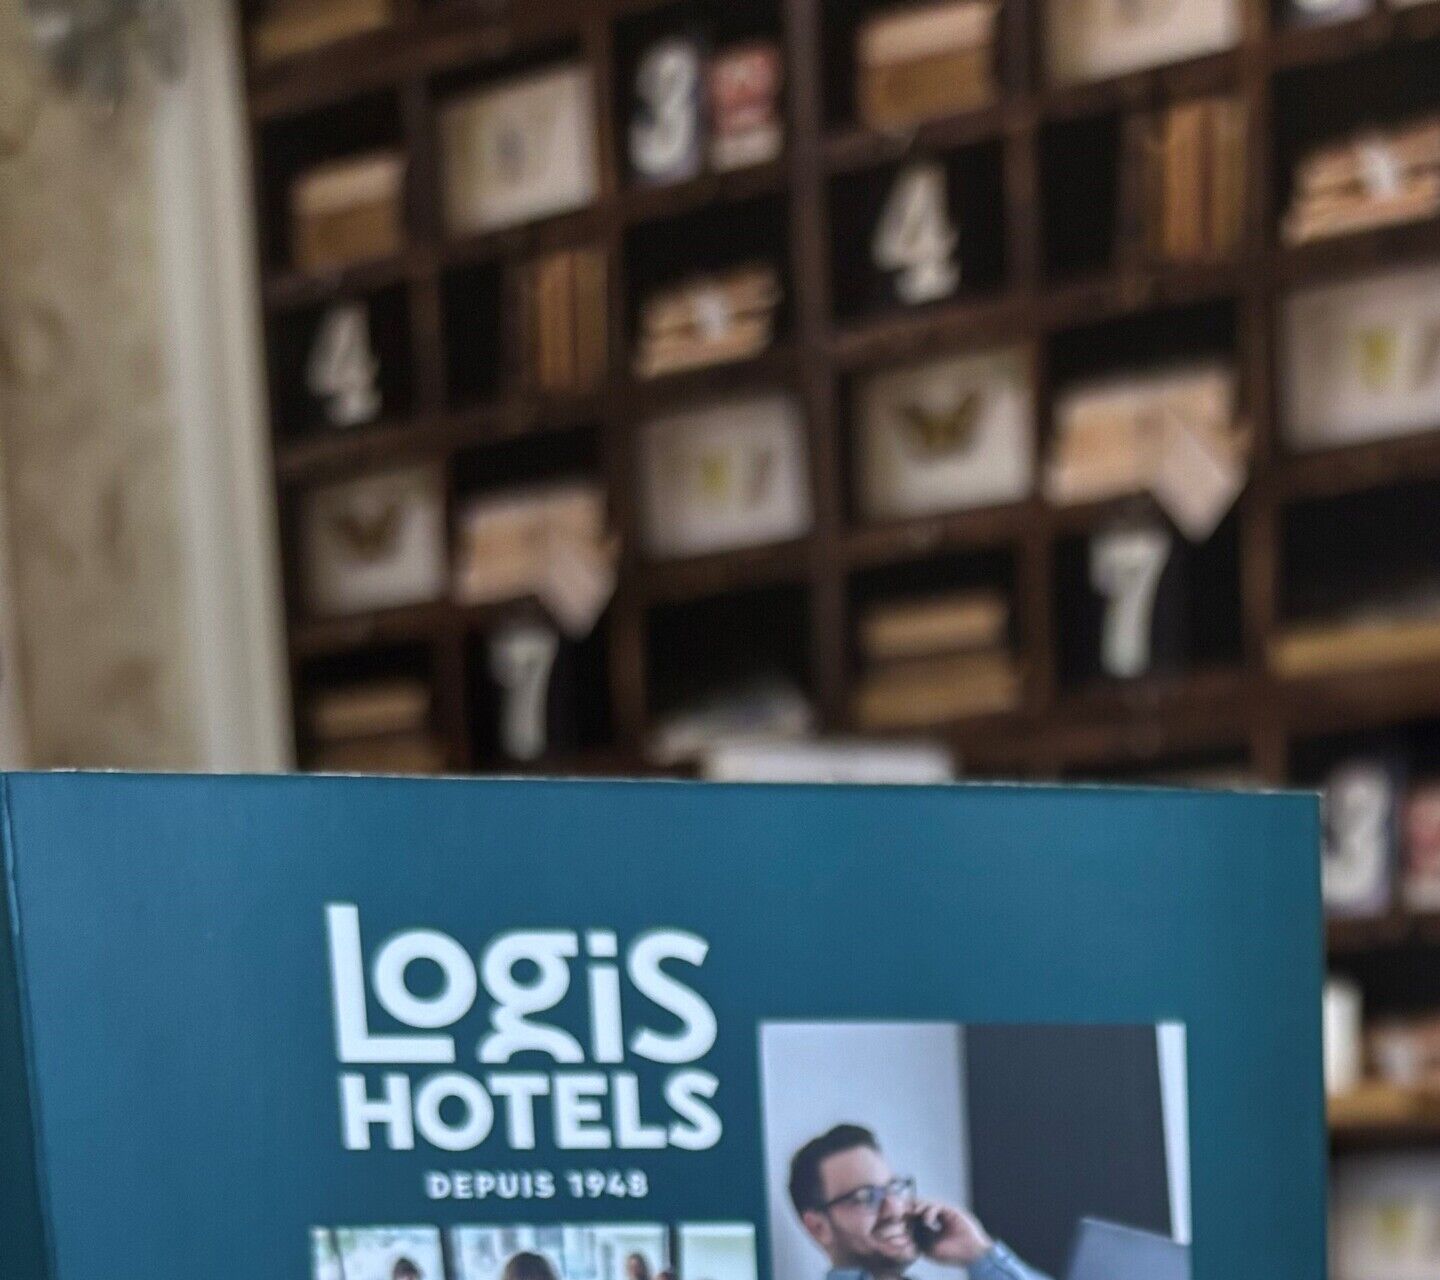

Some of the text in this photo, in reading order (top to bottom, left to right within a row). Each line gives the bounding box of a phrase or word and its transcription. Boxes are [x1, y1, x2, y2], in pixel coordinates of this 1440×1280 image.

[339, 1069, 723, 1152] HOTELS
[426, 1169, 649, 1200] DEPUIS 1948
